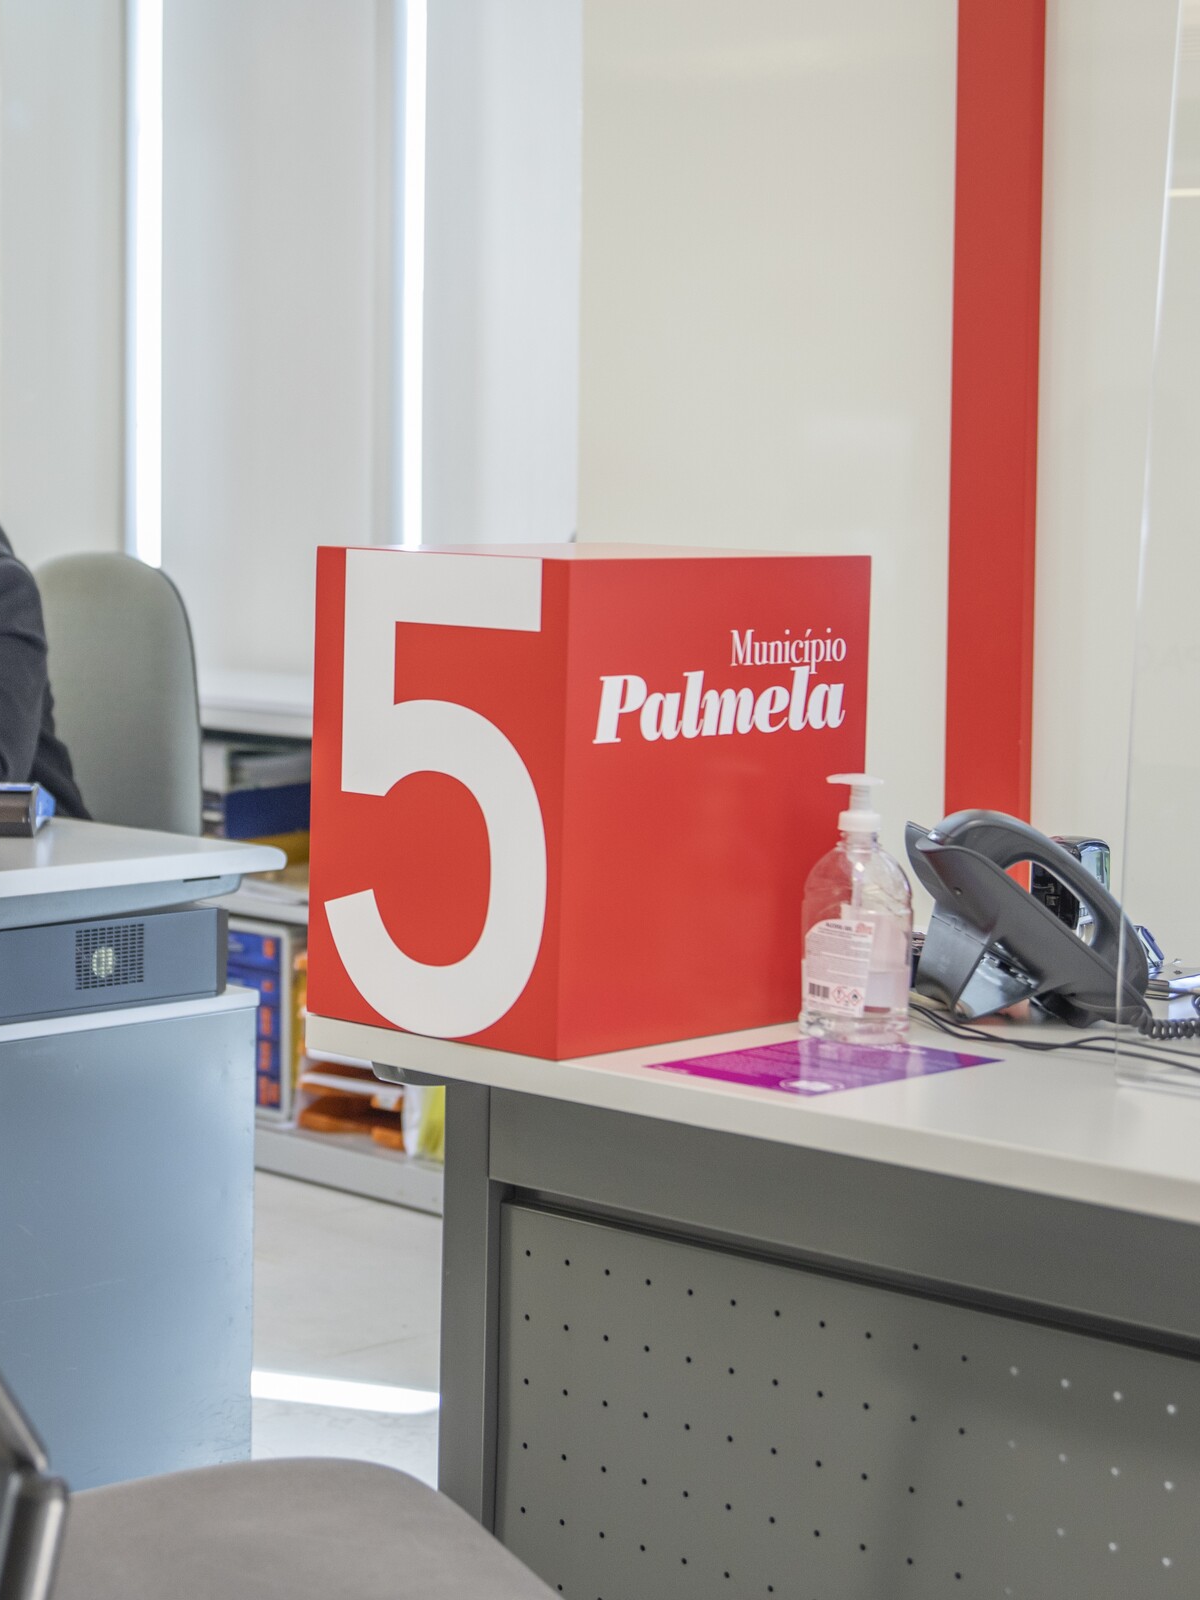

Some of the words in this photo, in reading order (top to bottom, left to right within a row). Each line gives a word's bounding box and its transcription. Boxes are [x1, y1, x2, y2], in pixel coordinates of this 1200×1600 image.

[730, 627, 847, 674] Município
[592, 665, 846, 744] Palmela
[323, 547, 547, 1038] 5
